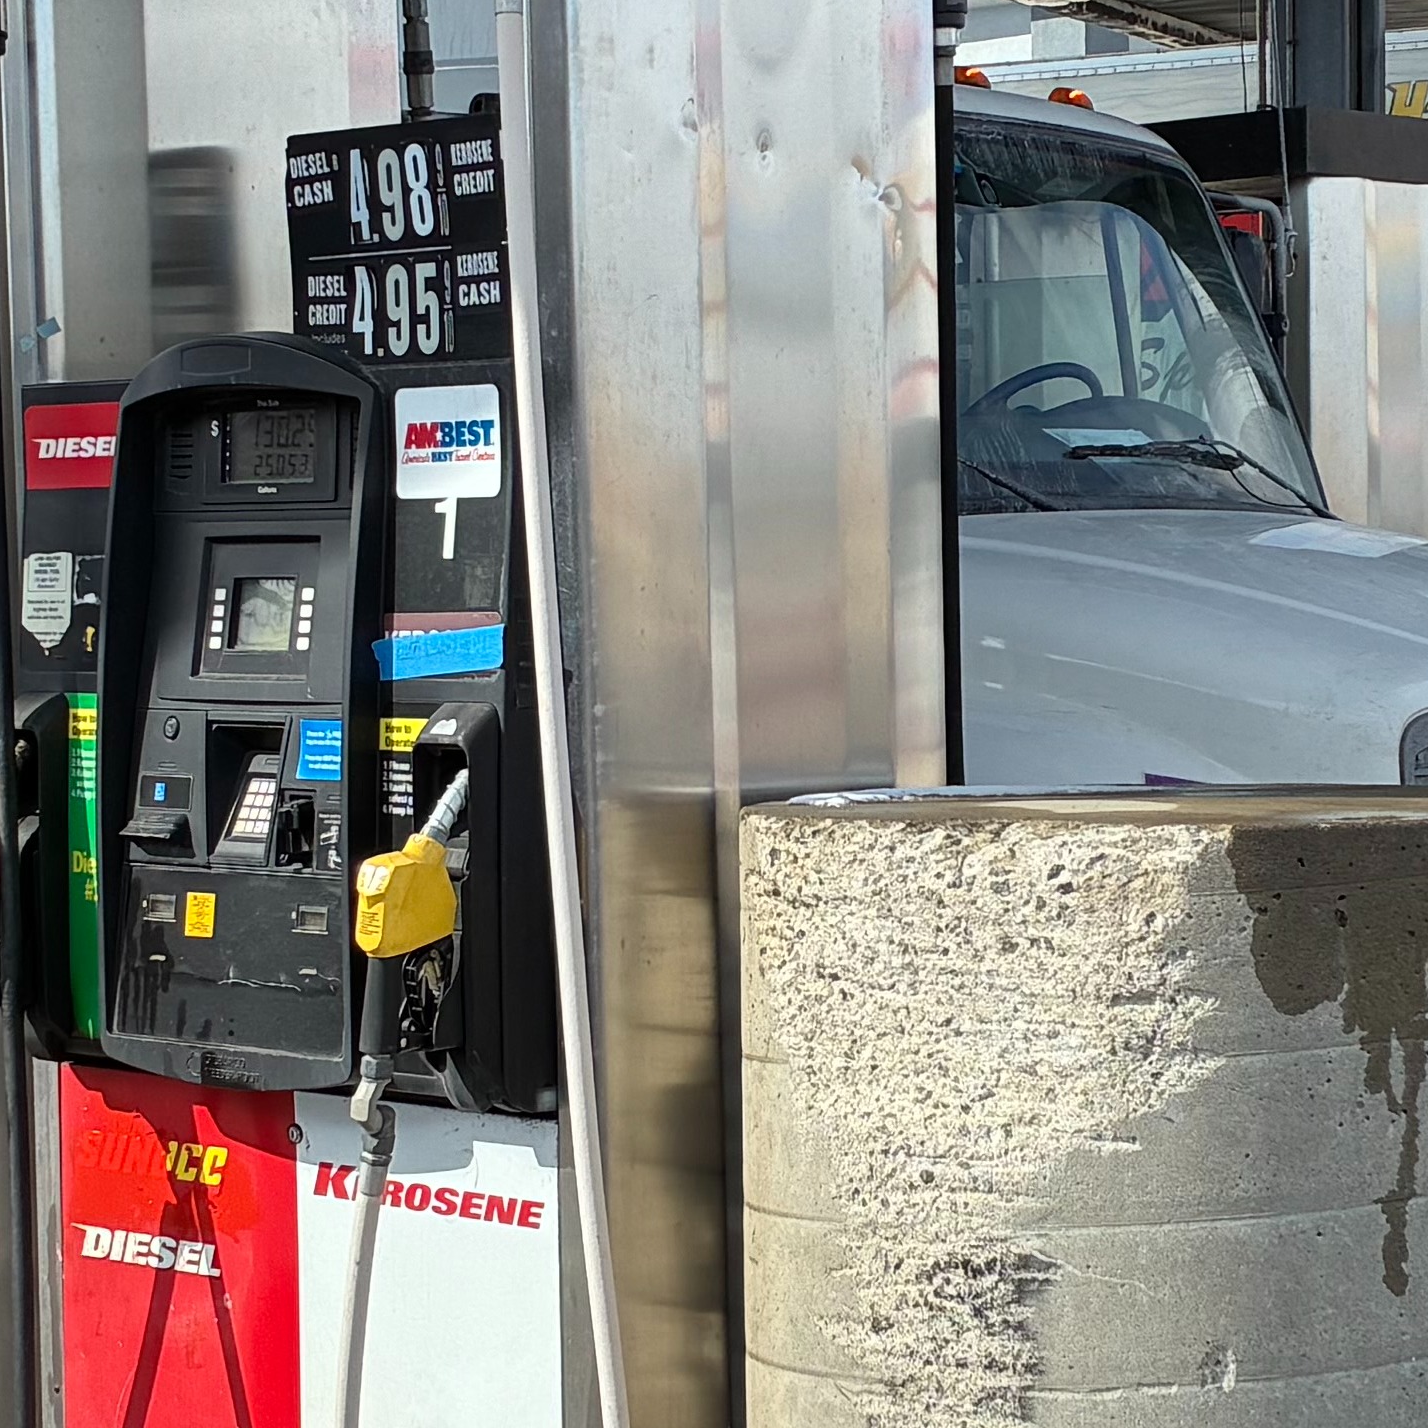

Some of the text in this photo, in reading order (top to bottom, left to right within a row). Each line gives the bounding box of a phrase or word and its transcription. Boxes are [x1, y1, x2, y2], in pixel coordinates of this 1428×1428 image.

[289, 152, 331, 178] DIESEL
[450, 139, 494, 166] KEROSENE
[293, 180, 333, 207] CASH
[453, 169, 495, 196] CREDIT
[457, 251, 499, 277] KEROSENE
[307, 275, 347, 297] DIESEL
[458, 281, 501, 306] CASH
[308, 304, 347, 326] CREDIT
[404, 420, 494, 449] AMBEST
[435, 497, 457, 559] 1
[385, 722, 412, 733] How to
[314, 1162, 545, 1229] KROSENE
[70, 1222, 222, 1278] DIESEL
